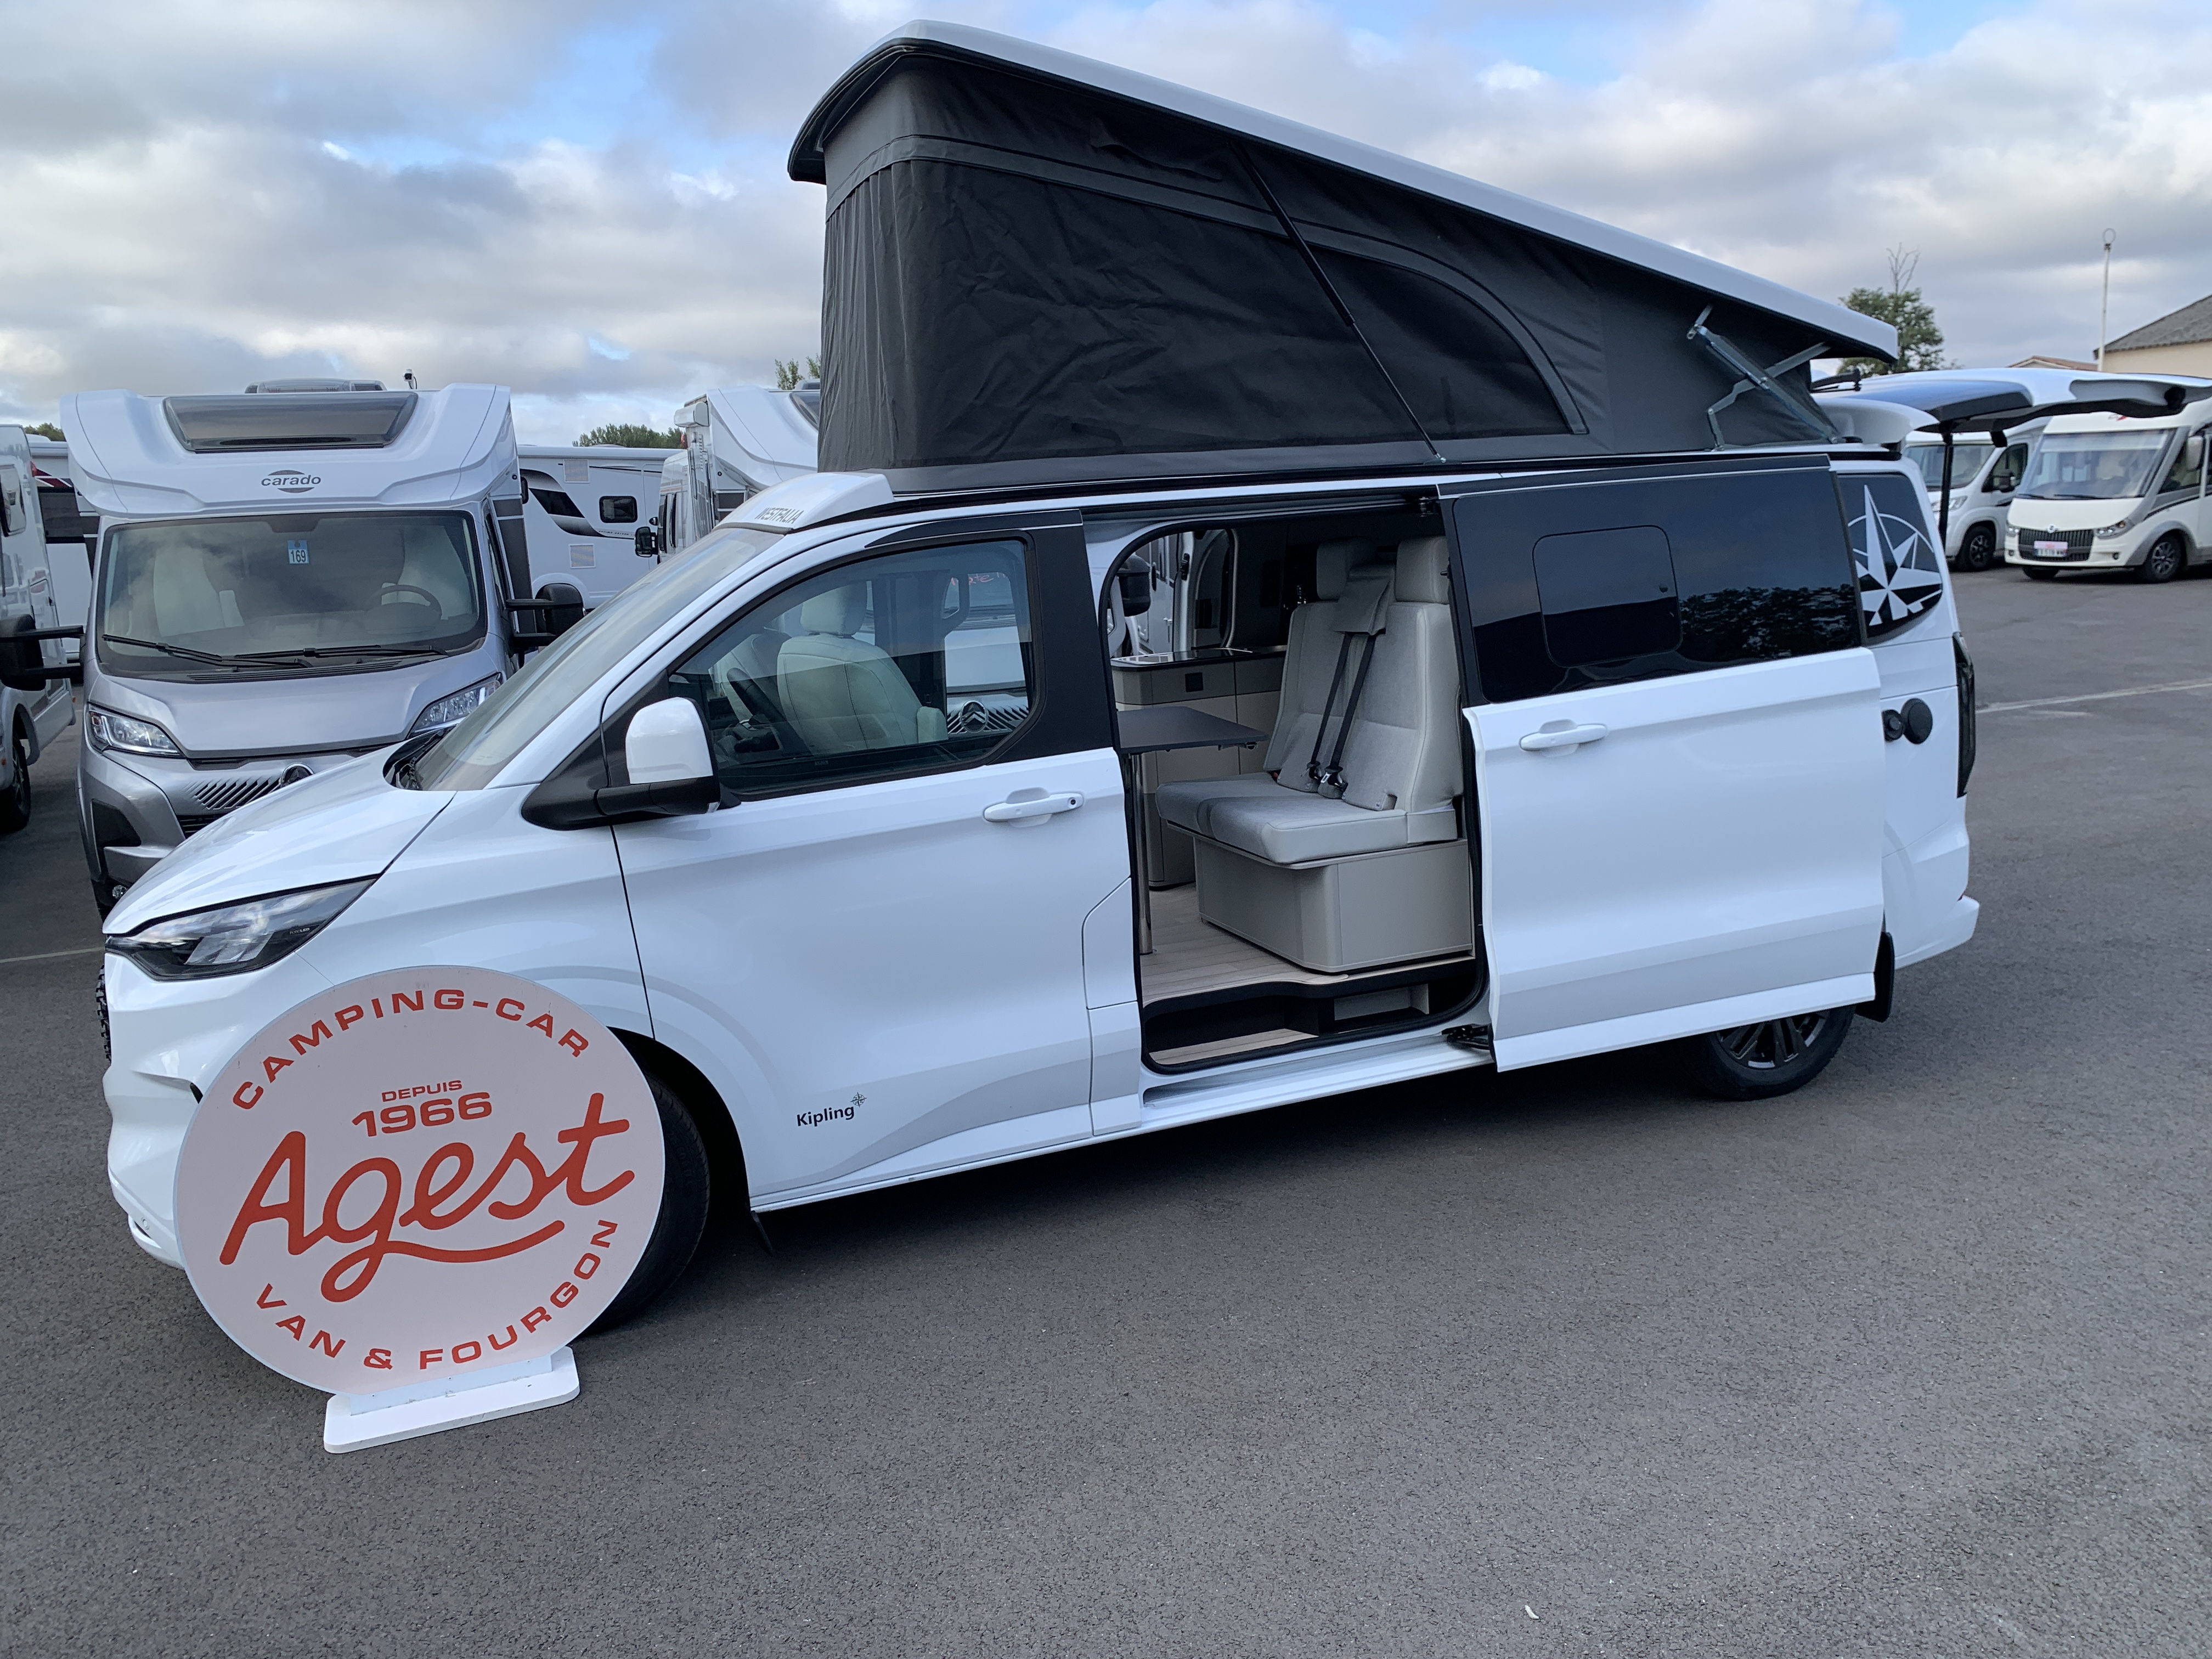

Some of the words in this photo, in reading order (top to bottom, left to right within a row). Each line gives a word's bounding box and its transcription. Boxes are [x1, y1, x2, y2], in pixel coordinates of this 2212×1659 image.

[261, 475, 321, 486] carado
[754, 507, 804, 524] WESTFALIA
[291, 550, 306, 563] 169
[233, 990, 588, 1109] CAMPING-CAR
[382, 1080, 462, 1102] DEPUIS
[352, 1092, 492, 1137] 1966
[797, 1106, 855, 1127] Kipling
[220, 1093, 635, 1302] Agest
[257, 1284, 345, 1357] VAN
[364, 1348, 393, 1370] &
[419, 1220, 617, 1370] FOURGON
